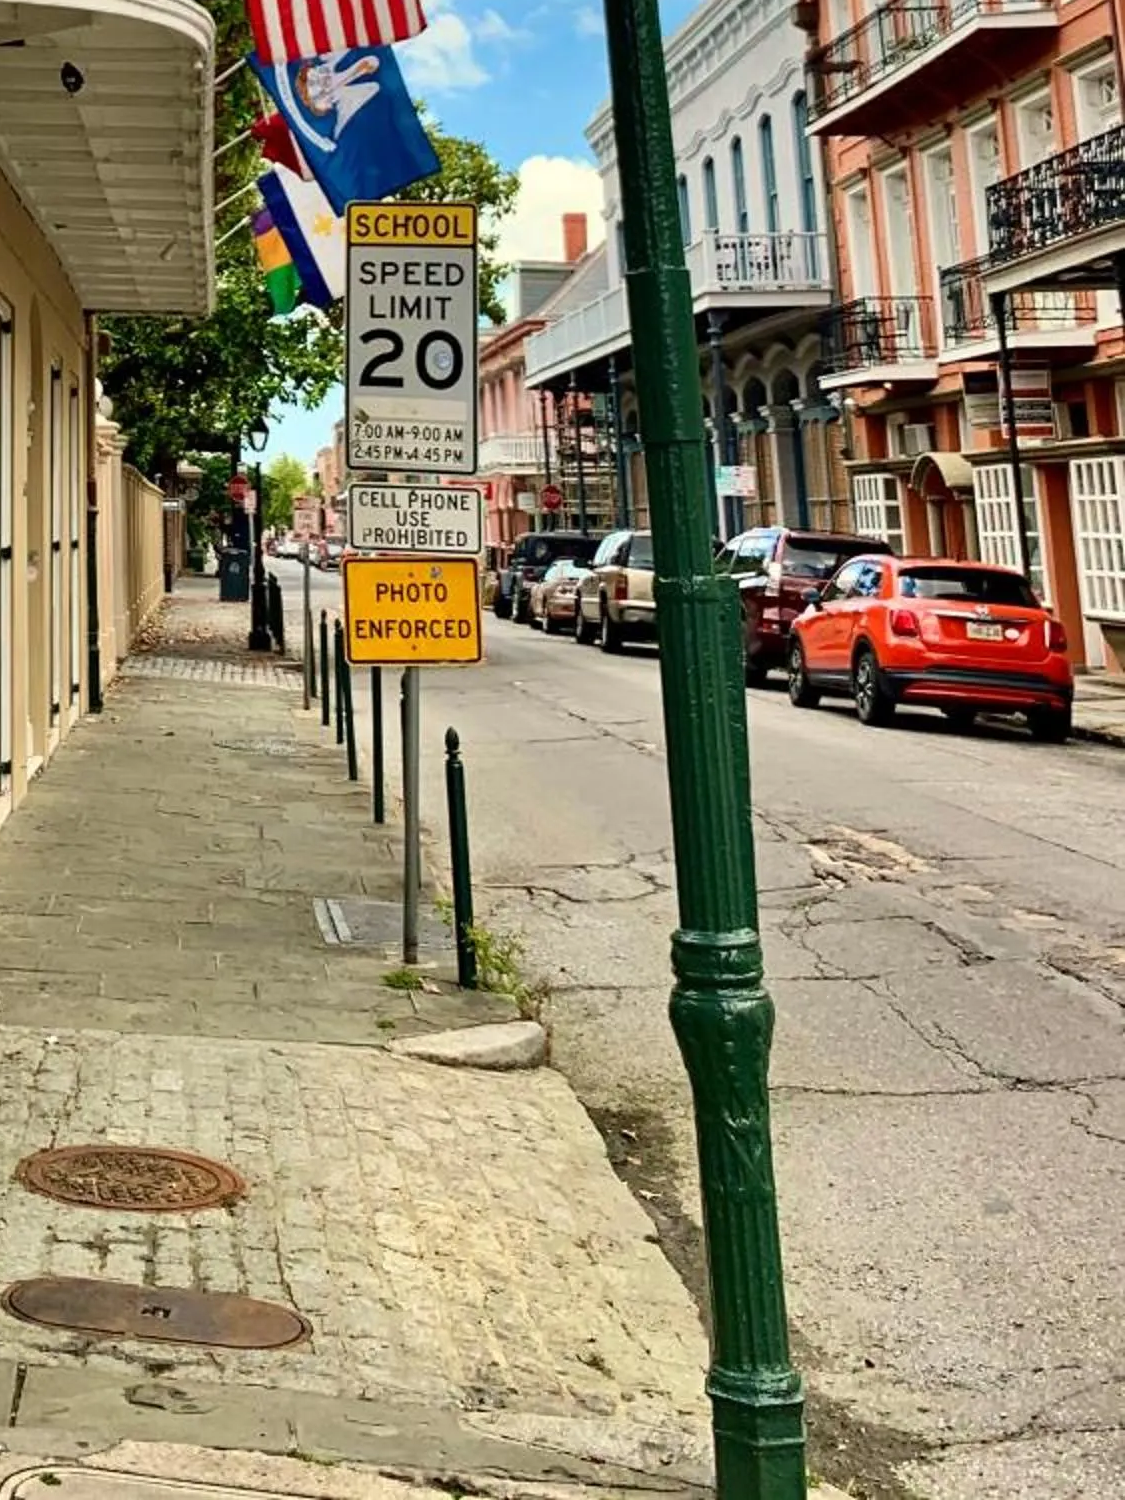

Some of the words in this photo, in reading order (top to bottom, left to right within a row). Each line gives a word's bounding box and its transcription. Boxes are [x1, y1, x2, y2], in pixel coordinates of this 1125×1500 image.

[354, 213, 468, 239] SCHOOL
[359, 261, 464, 286] SPEED
[369, 296, 452, 320] LIMIT
[359, 329, 463, 390] 20
[445, 428, 463, 442] AM
[444, 448, 463, 463] PM
[359, 491, 401, 509] CELL
[408, 491, 470, 510] PHONE
[396, 511, 429, 528] USE
[363, 529, 467, 547] PROHIBITED
[376, 584, 448, 603] PHOTO
[355, 620, 472, 639] ENFORCED
